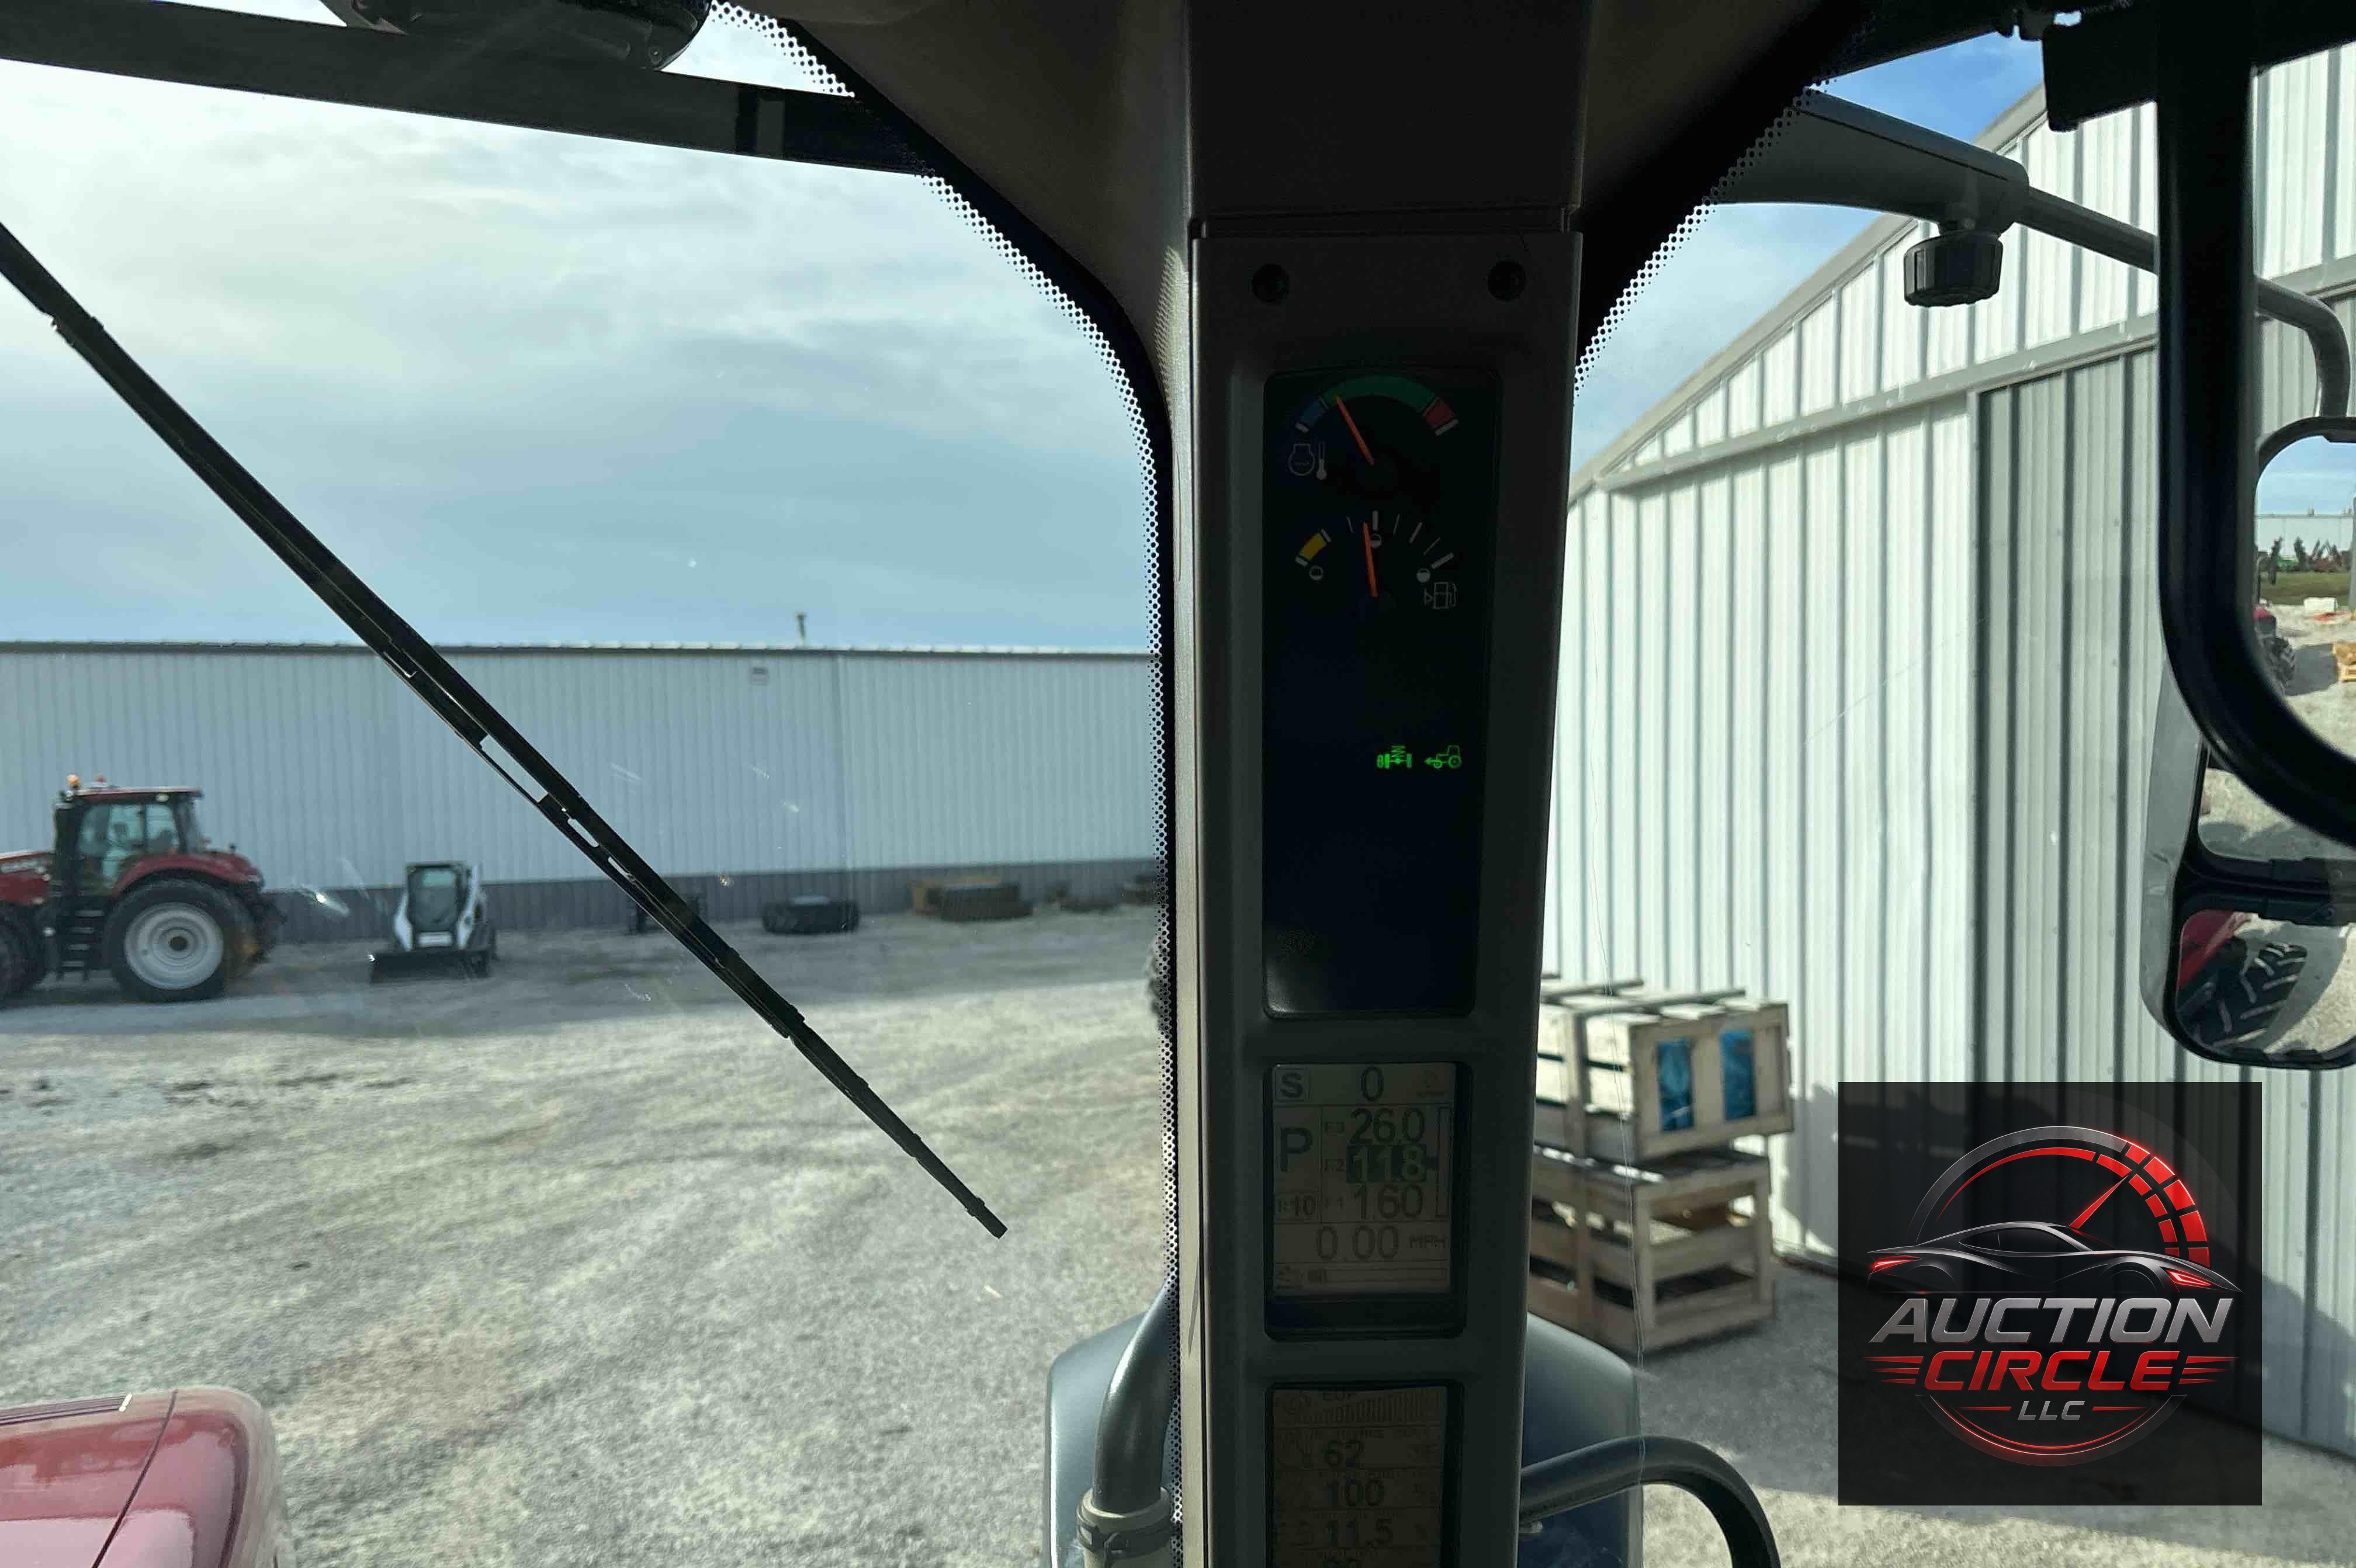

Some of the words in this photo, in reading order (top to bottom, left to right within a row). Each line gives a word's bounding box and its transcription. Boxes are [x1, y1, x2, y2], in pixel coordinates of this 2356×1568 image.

[1280, 1072, 1304, 1098] S
[1360, 1066, 1384, 1102] 0
[1280, 1126, 1314, 1172] P
[1326, 1479, 1385, 1507] 100
